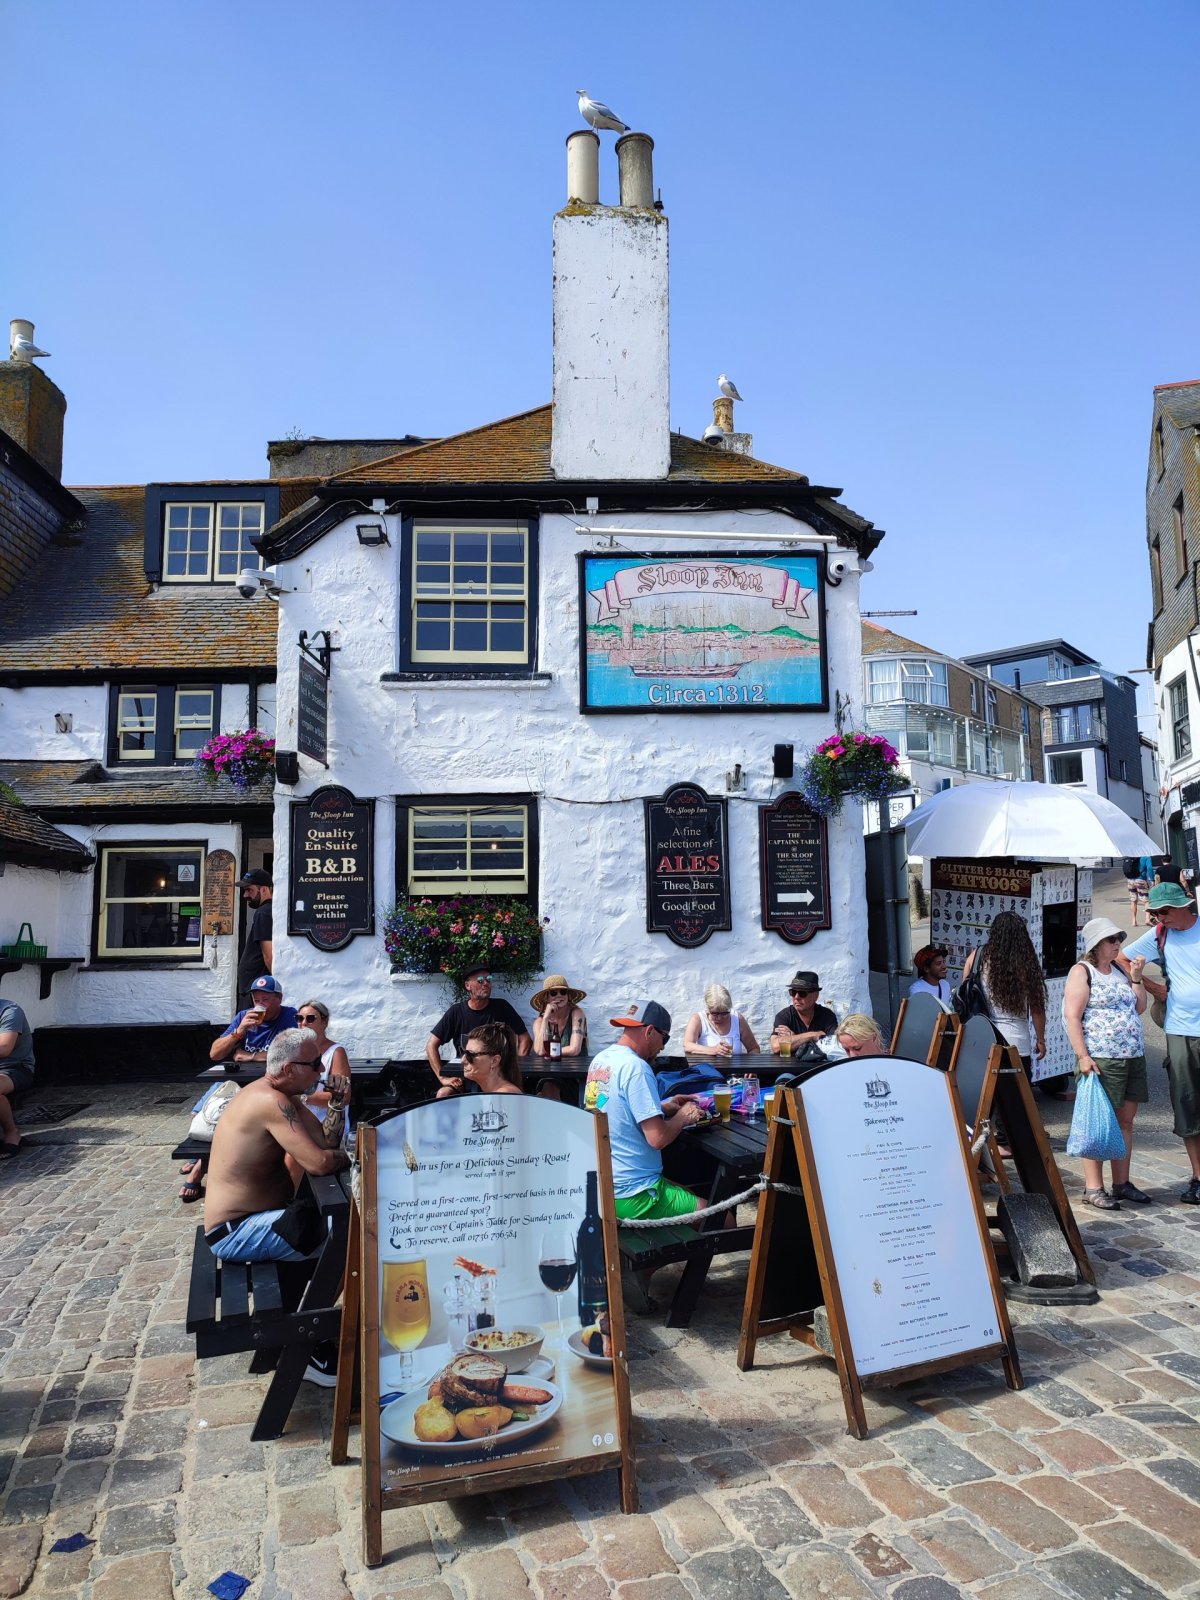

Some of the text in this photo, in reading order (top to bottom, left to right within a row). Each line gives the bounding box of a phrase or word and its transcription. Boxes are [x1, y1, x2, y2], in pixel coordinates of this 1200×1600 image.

[638, 564, 763, 593] Sloop Inn
[321, 811, 342, 820] Sloop
[676, 807, 695, 815] Sloop
[307, 828, 355, 842] Quality
[672, 826, 701, 836] A fine
[304, 841, 358, 851] En-Suite
[659, 839, 714, 849] selection of
[306, 857, 357, 875] B&B
[656, 855, 720, 873] ALES
[940, 862, 1031, 879] GLITTER & BLACK
[662, 880, 714, 890] Three Bars
[949, 873, 1020, 892] TATTOOS
[313, 902, 349, 911] enquire
[662, 901, 716, 911] Good Food
[463, 1136, 515, 1147] The Sloop Inn
[439, 1160, 454, 1174] for
[463, 1155, 505, 1171] Delicious
[506, 1155, 540, 1168] Sunday
[541, 1152, 571, 1166] Roast!
[388, 1199, 418, 1210] Served
[437, 1195, 481, 1209] first-come,
[481, 1189, 528, 1204] first-served
[530, 1188, 546, 1197] basis
[570, 1185, 584, 1196] pub.
[389, 1211, 418, 1224] Prefer
[425, 1207, 469, 1221] guaranteed
[470, 1206, 491, 1217] spot?
[389, 1225, 411, 1237] Book
[430, 1224, 447, 1233] cosy
[448, 1218, 484, 1232] Captain's
[486, 1217, 507, 1228] Table
[508, 1215, 521, 1228] for
[521, 1212, 553, 1226] Sunday
[554, 1211, 575, 1220] lunch.
[405, 1237, 417, 1248] To
[452, 1233, 466, 1242] call
[468, 1232, 488, 1242] 01736
[396, 1467, 410, 1475] Sloop
